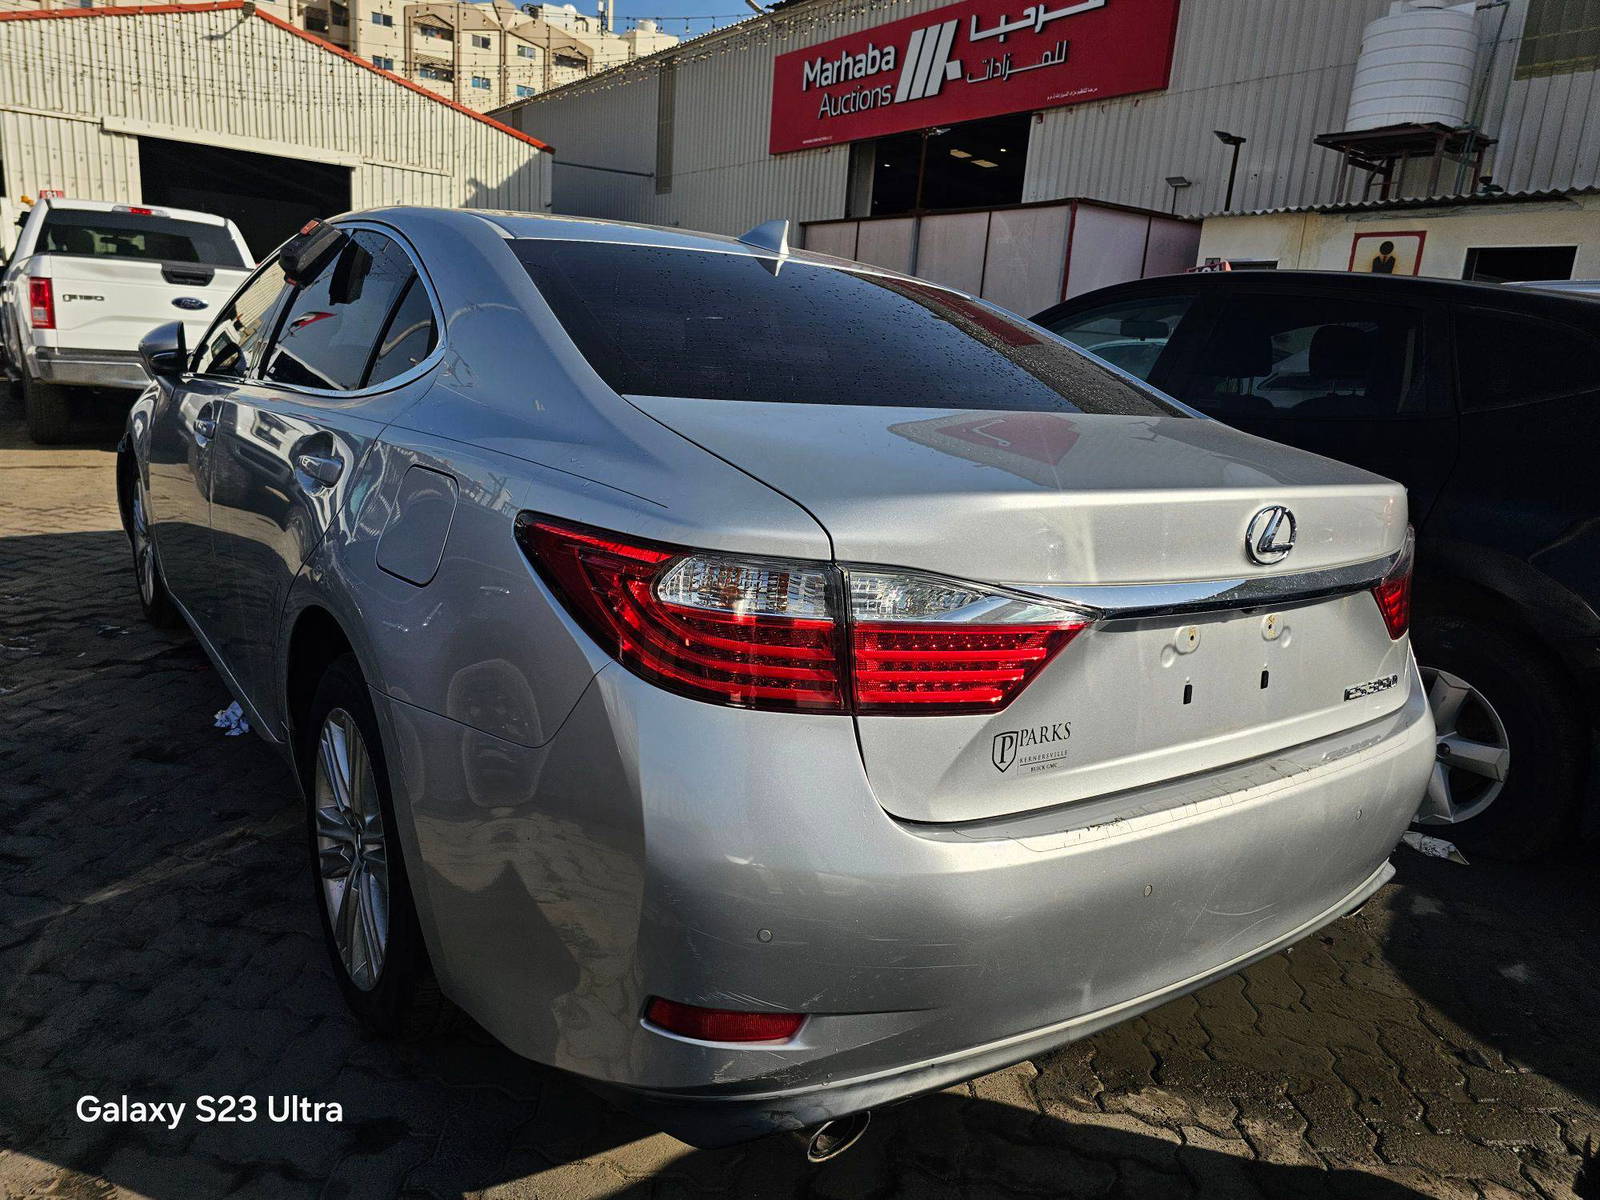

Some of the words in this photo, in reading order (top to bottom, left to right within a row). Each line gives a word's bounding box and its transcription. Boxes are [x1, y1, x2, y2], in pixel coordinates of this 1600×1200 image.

[802, 42, 895, 91] Marhaba
[967, 40, 1067, 83] للمزادات
[818, 85, 891, 119] Auctions
[1020, 722, 1071, 747] PARKS
